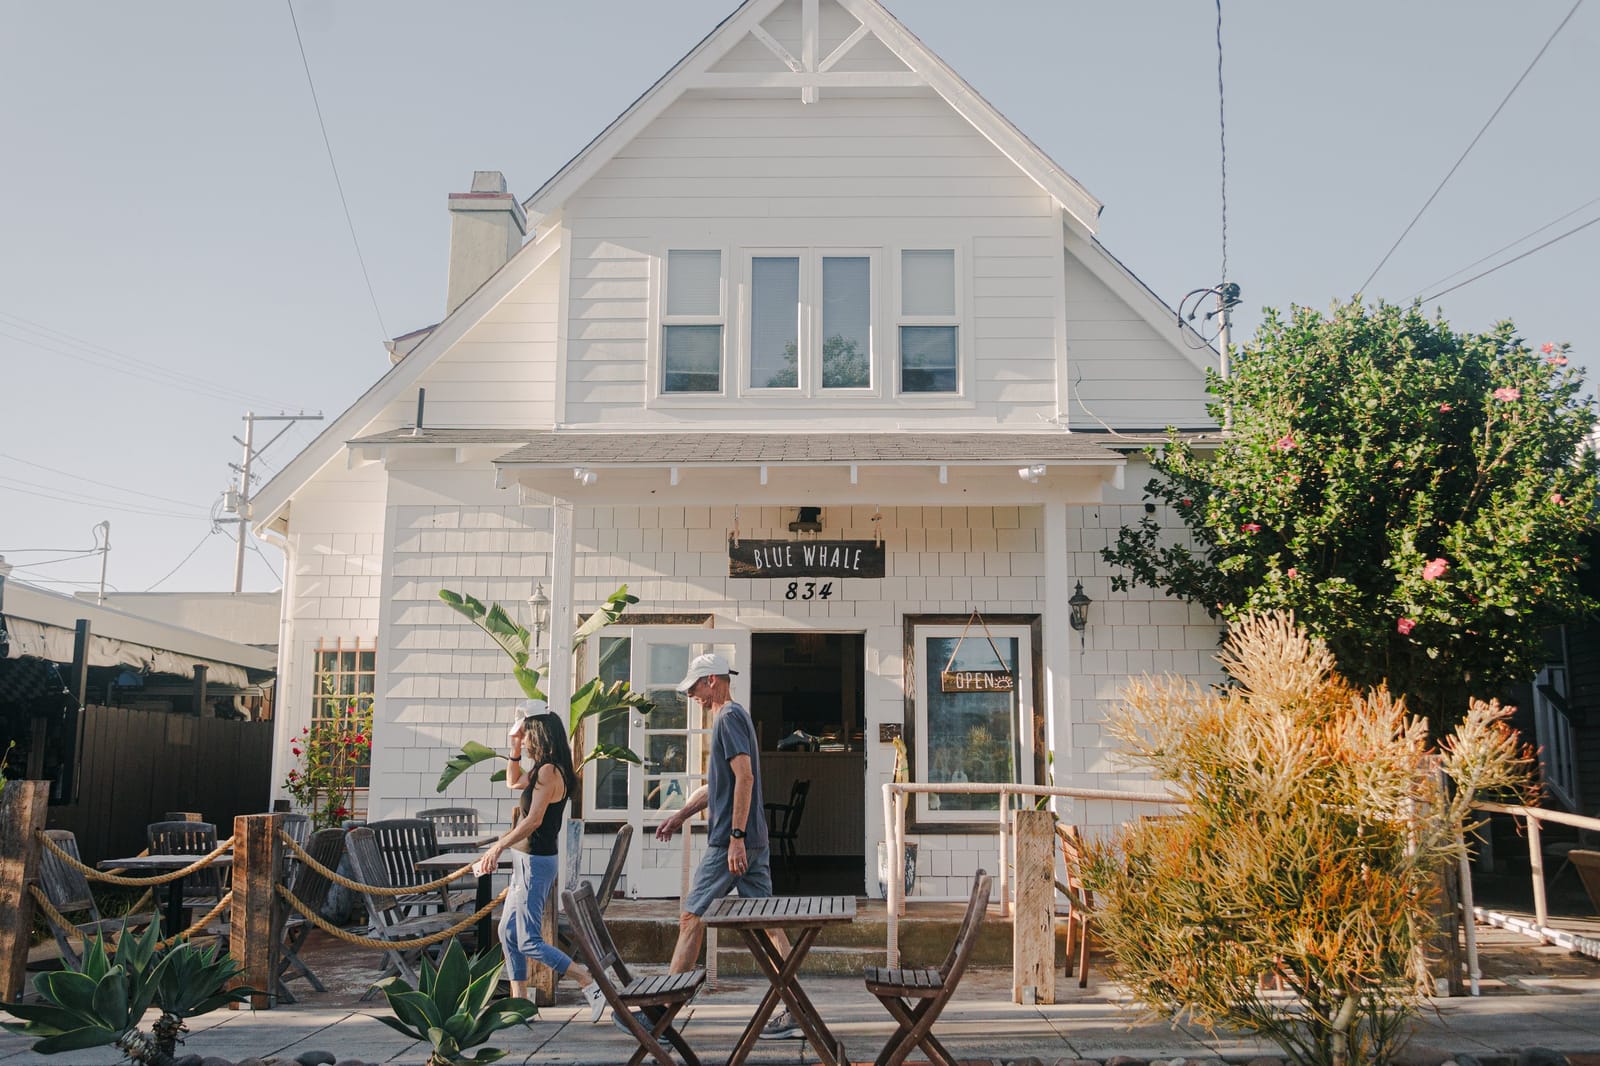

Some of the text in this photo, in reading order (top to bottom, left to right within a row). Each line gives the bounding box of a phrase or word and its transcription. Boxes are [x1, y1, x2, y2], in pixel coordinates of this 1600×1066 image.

[754, 545, 862, 570] BLUE WHALE
[785, 582, 833, 600] 834
[956, 672, 995, 689] OPEN
[666, 779, 683, 796] A
